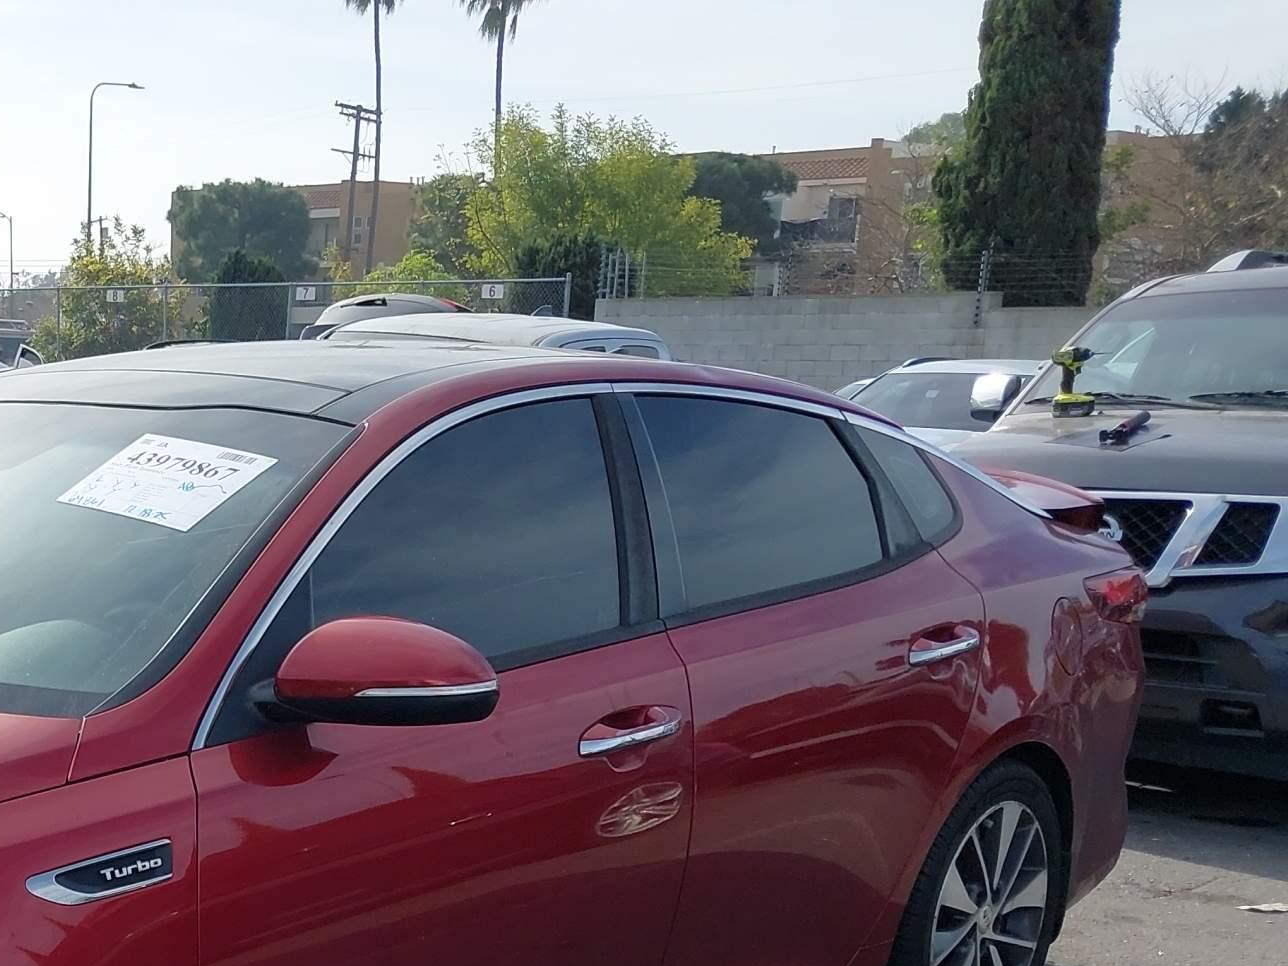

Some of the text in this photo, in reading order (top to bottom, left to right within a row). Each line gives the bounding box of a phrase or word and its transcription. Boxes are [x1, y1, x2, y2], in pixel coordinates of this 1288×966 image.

[112, 290, 118, 302] 8
[303, 287, 310, 299] 7
[488, 285, 496, 297] 6
[127, 451, 241, 481] 43979867
[100, 857, 162, 881] Turbo
